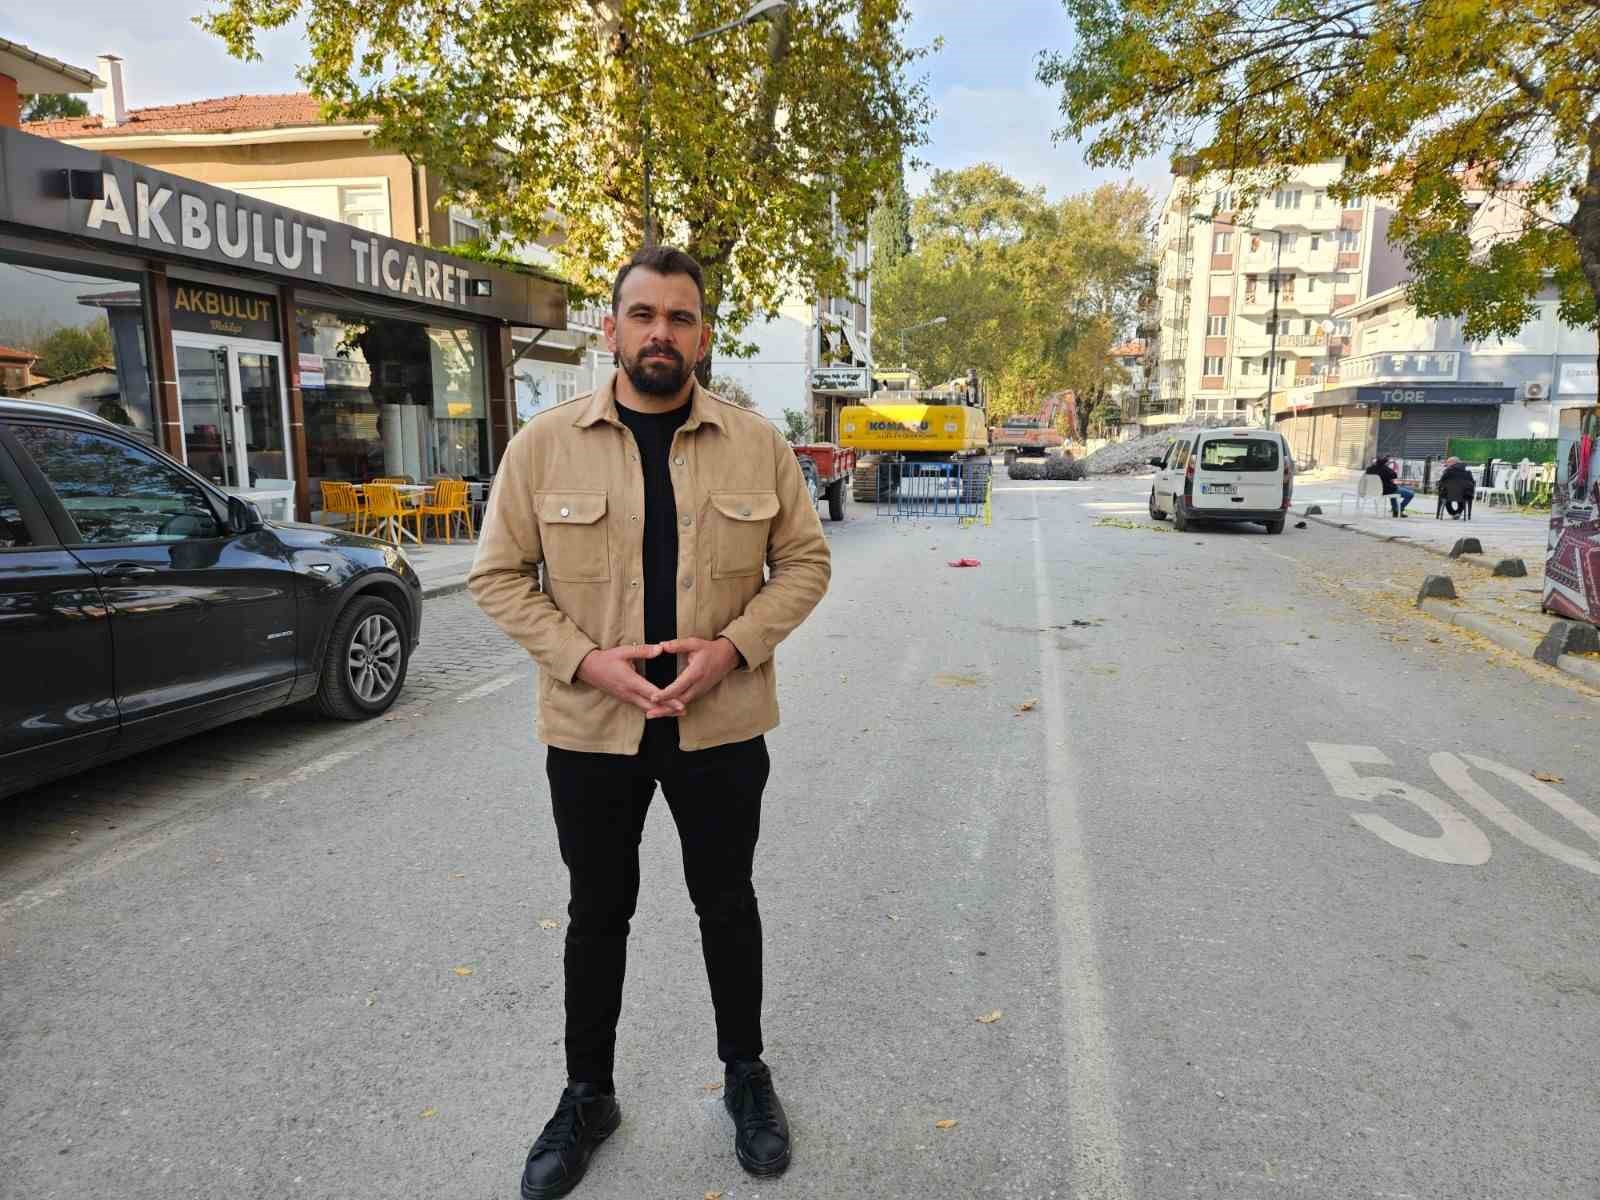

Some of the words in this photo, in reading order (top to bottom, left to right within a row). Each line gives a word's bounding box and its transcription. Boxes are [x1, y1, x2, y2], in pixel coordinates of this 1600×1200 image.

[86, 172, 328, 275] AKBULUT
[350, 237, 470, 305] TİCARET
[174, 287, 271, 322] AKBULUT
[1306, 741, 1600, 876] 50
